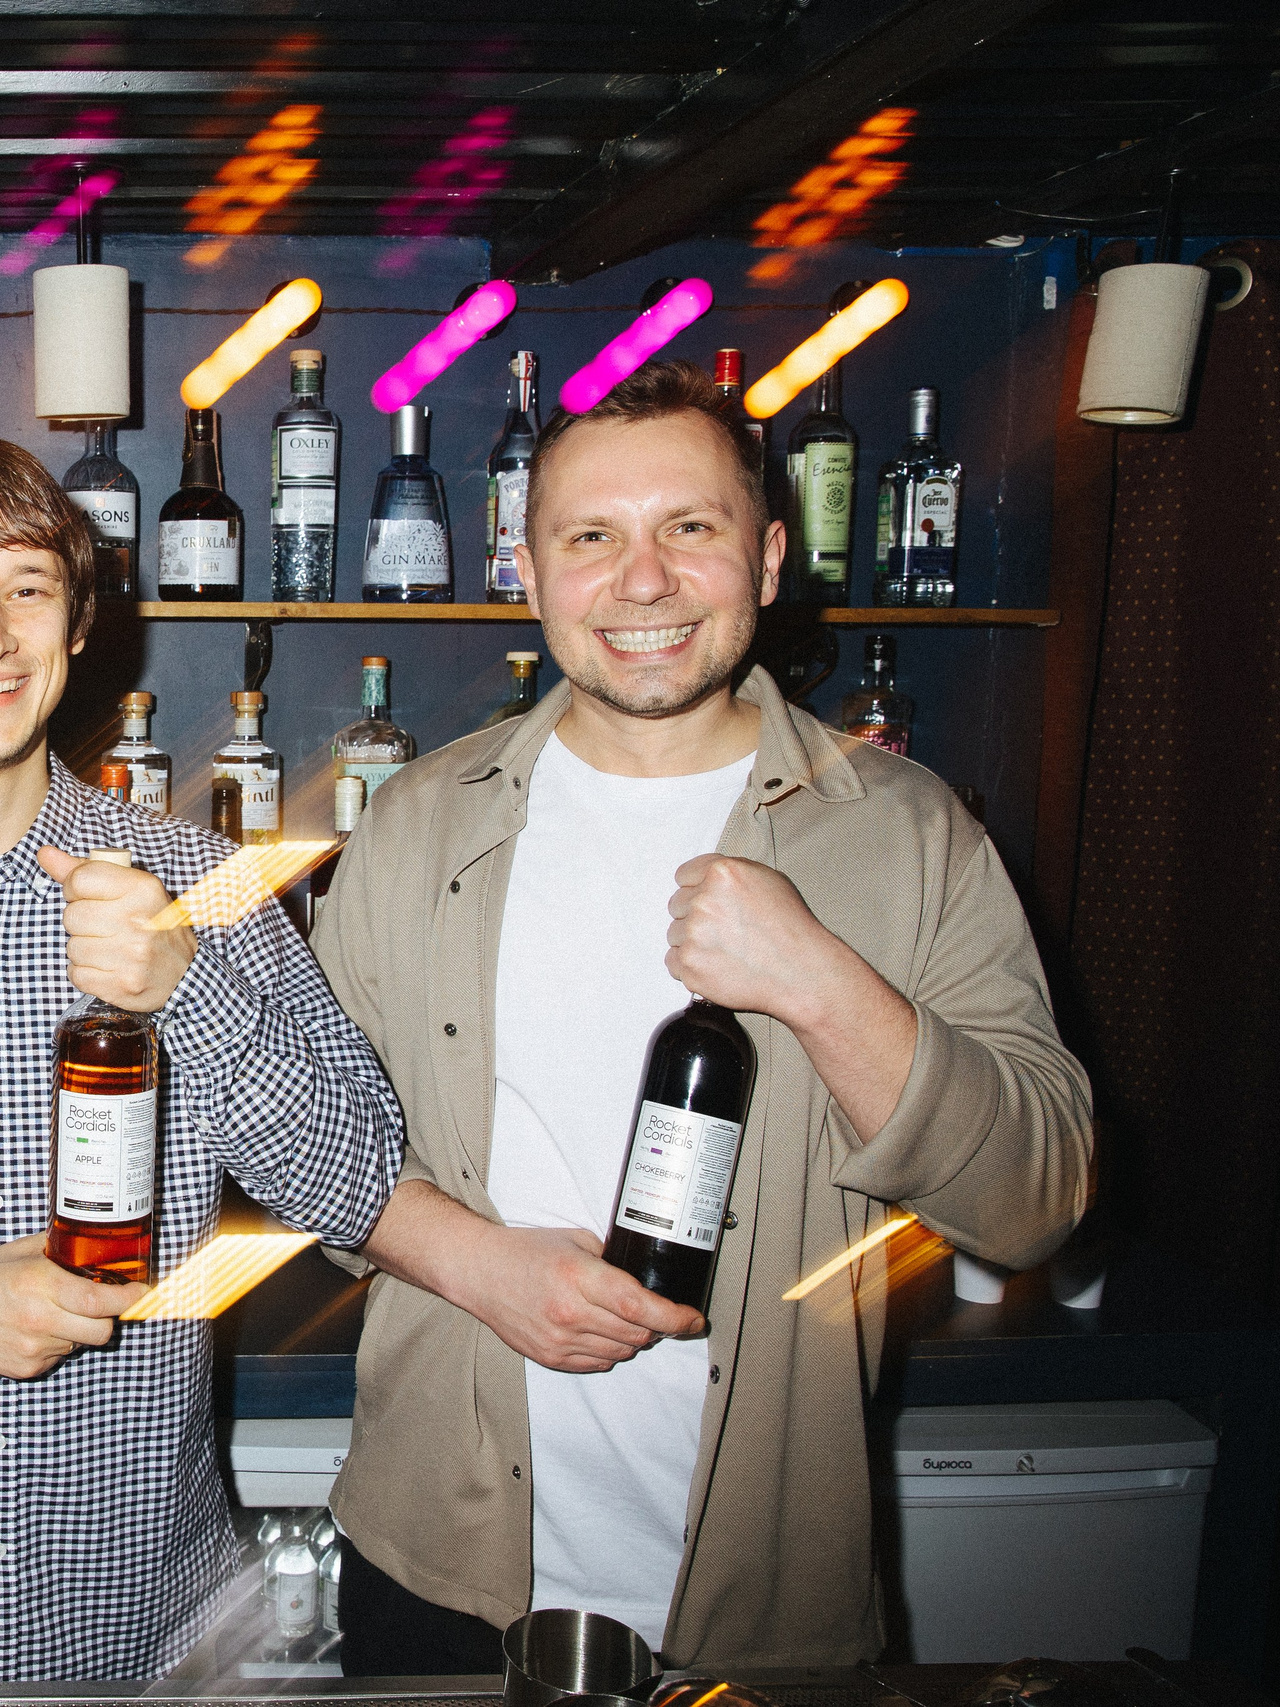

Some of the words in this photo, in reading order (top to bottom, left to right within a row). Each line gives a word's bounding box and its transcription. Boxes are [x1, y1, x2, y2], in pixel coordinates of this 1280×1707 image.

[290, 437, 331, 450] OXLEY
[812, 462, 852, 477] Esencia
[922, 494, 950, 509] Cuervo
[81, 509, 130, 523] ASONS
[181, 536, 236, 549] CRUXLAND
[381, 554, 410, 566] GIN
[414, 554, 449, 566] MARE
[131, 788, 164, 804] intl
[241, 787, 274, 803] intl
[69, 1104, 113, 1120] Rocket
[65, 1116, 116, 1133] Cordials
[649, 1114, 693, 1137] Rocket
[643, 1126, 694, 1150] Cordials
[74, 1154, 103, 1165] APPLE
[634, 1162, 686, 1182] CHOKEBERRY
[923, 1458, 973, 1471] бирюса
